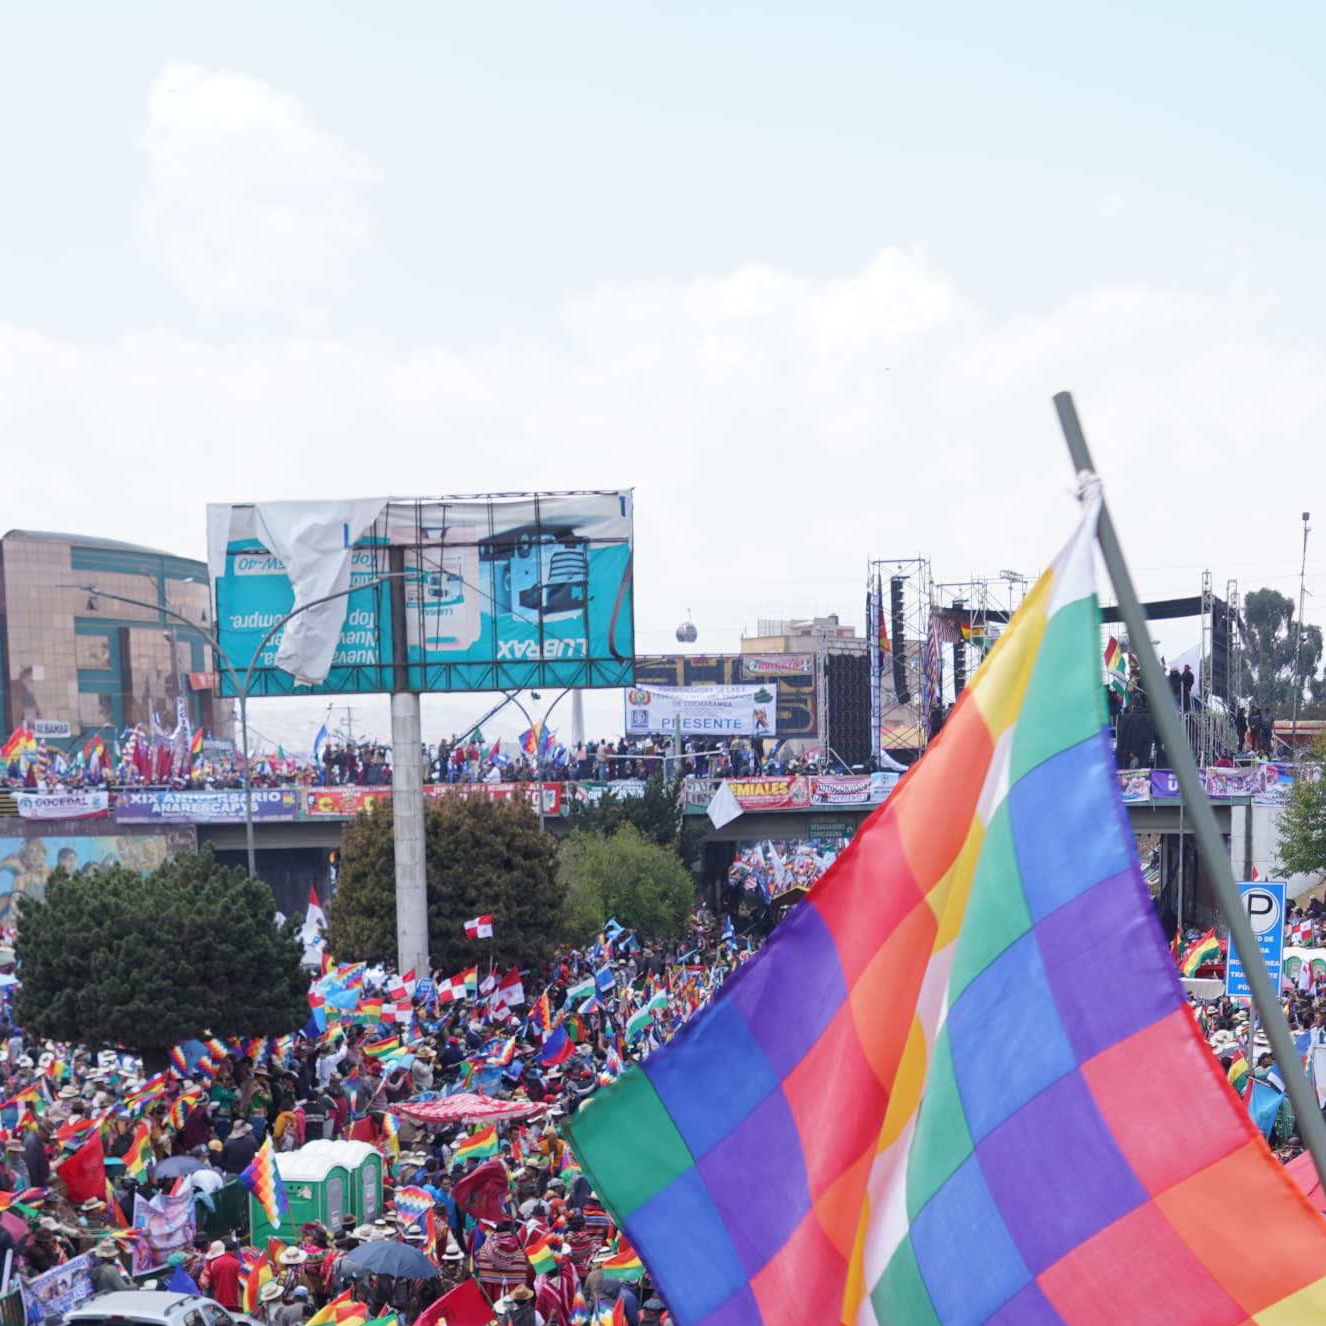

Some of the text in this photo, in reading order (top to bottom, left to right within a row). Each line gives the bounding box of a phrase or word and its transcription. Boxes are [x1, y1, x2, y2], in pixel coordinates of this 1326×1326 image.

[349, 609, 375, 629] Top
[498, 637, 587, 660] LUBRAX
[130, 791, 282, 804] XIX ANIVERSARIO
